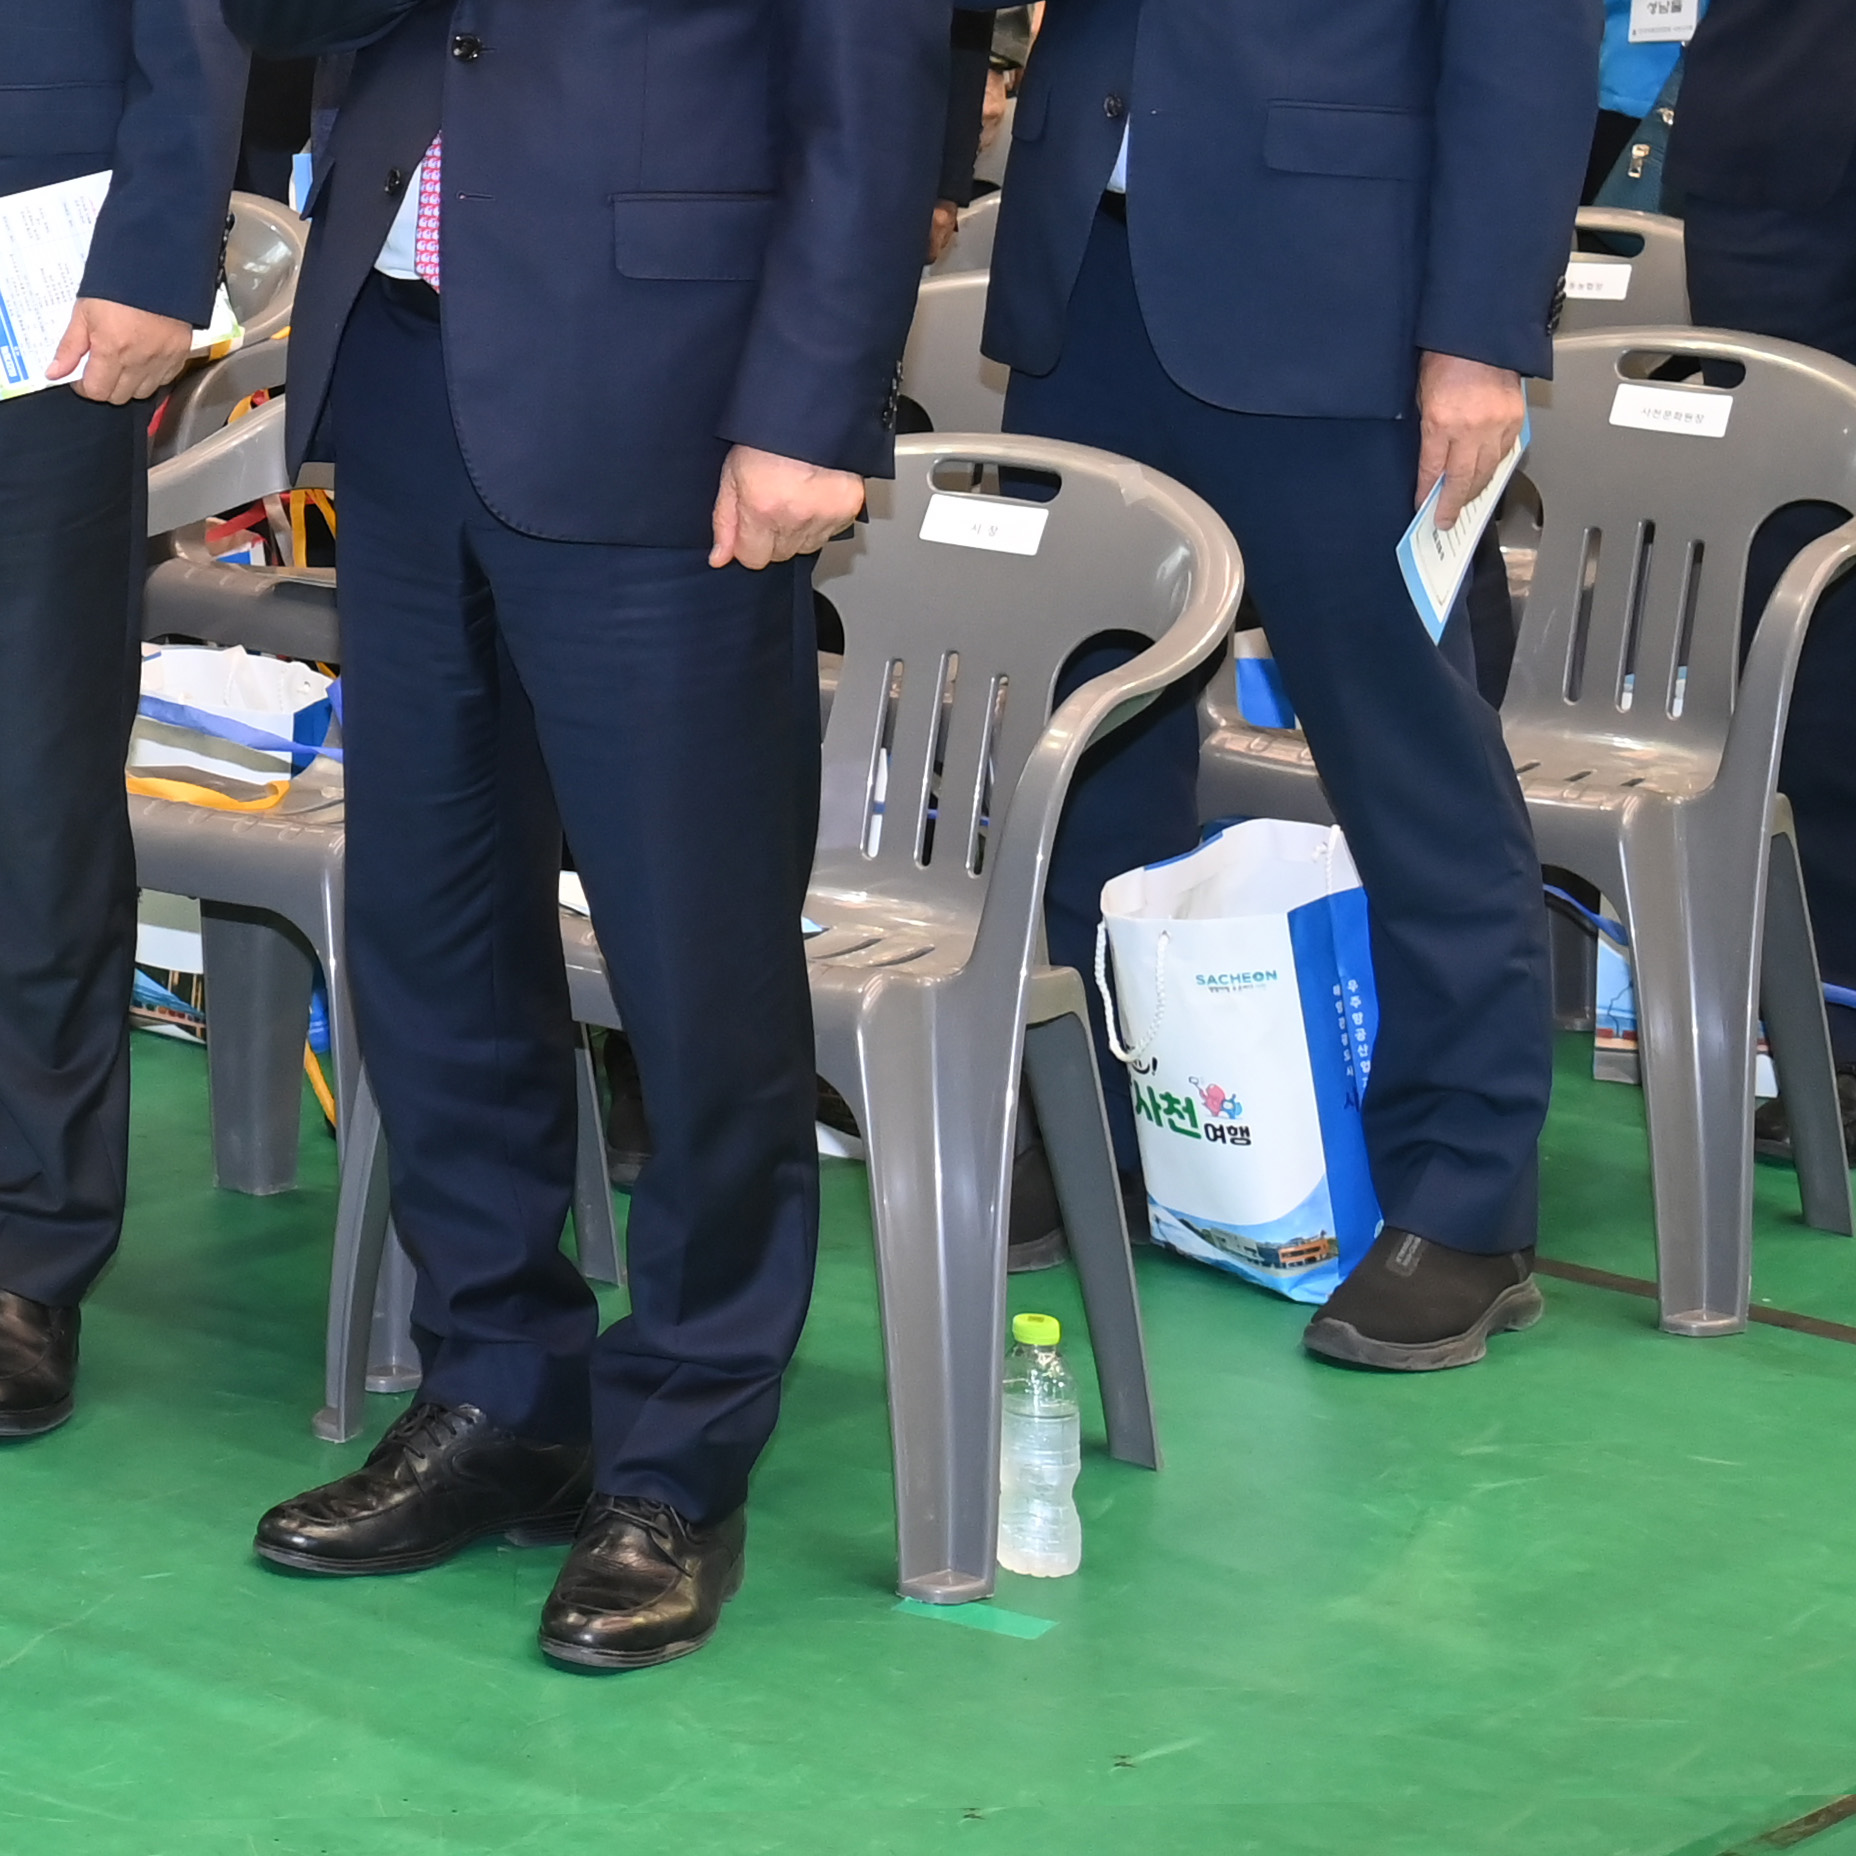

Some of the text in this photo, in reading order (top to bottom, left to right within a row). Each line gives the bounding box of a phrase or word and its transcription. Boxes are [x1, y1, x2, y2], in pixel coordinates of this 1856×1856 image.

[1195, 970, 1278, 986] SACHEON
[1133, 1079, 1252, 1146] 사천 여행
